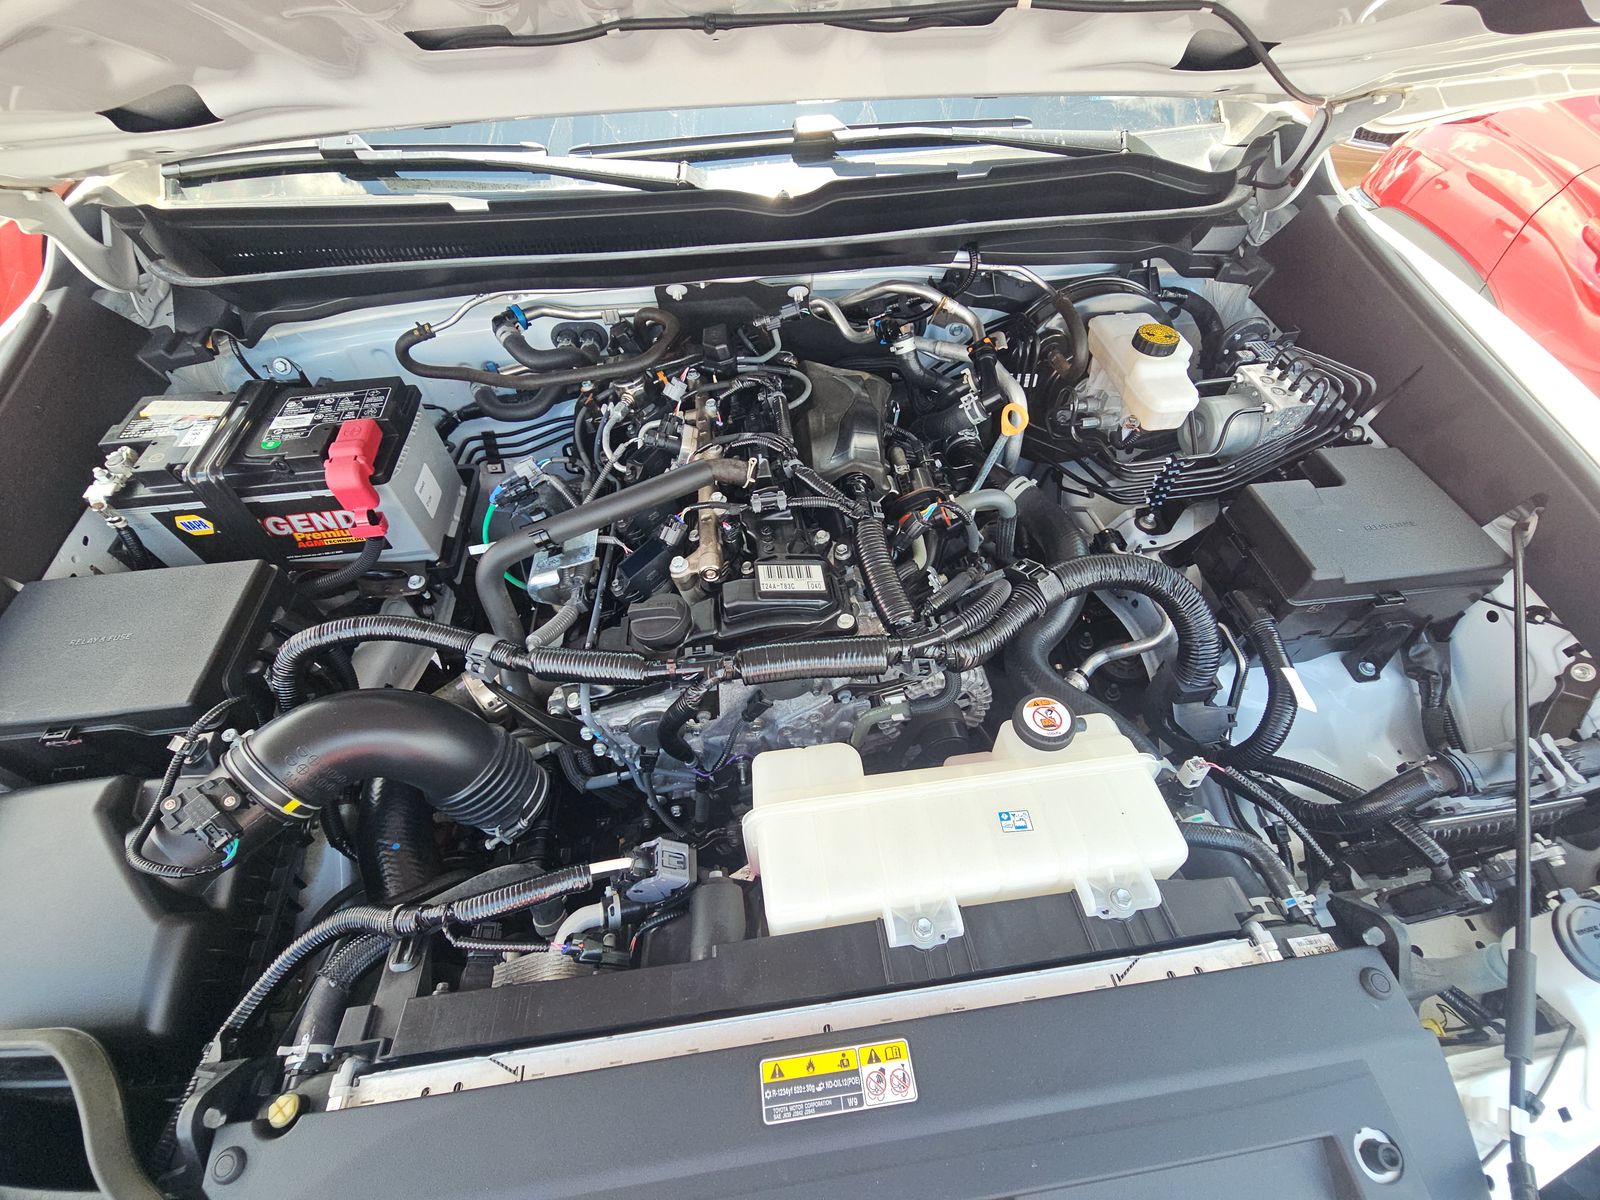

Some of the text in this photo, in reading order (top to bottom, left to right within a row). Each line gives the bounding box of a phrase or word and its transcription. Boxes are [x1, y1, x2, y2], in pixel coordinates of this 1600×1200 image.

[179, 519, 211, 531] NAPA
[258, 509, 356, 536] GEND
[298, 539, 325, 548] AGM
[773, 1099, 833, 1114] TOYOTA MOTOR CORPORATION
[847, 1097, 859, 1107] W9
